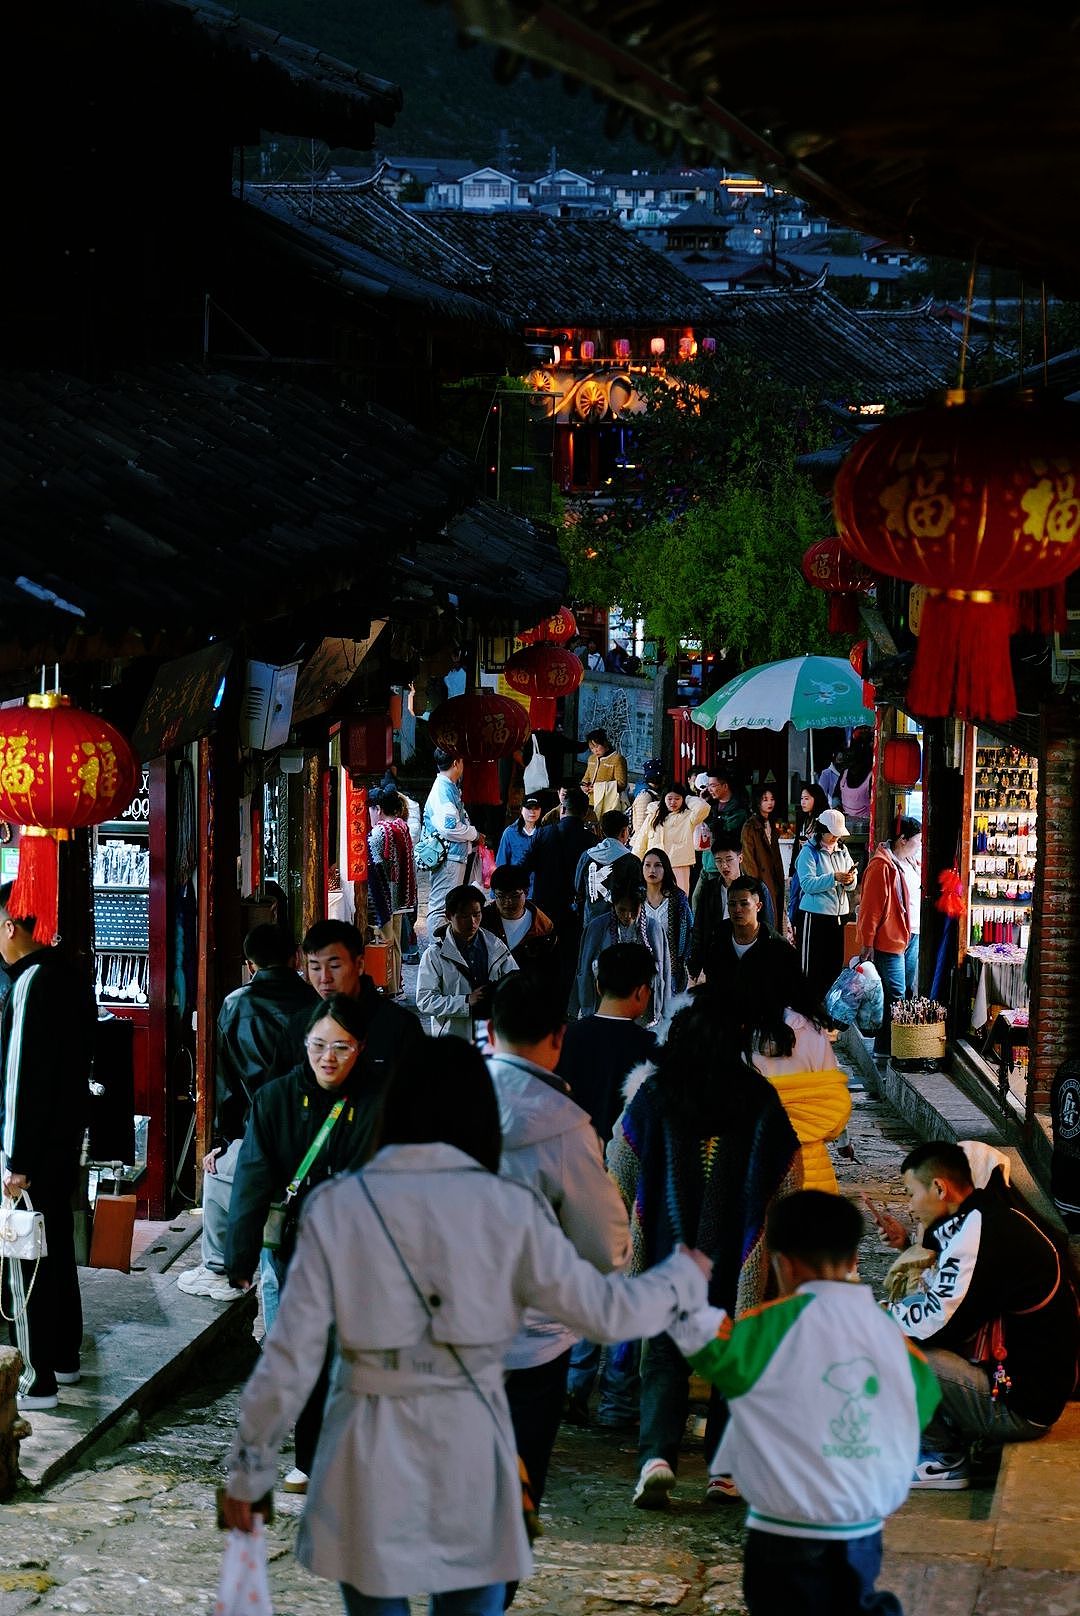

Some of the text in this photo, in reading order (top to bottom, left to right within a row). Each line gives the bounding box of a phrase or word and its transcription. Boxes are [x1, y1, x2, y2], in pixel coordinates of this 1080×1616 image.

[879, 451, 956, 539] 福
[810, 553, 831, 579] 福
[548, 614, 565, 634] 福
[547, 662, 569, 686] 福
[480, 713, 510, 744] 福
